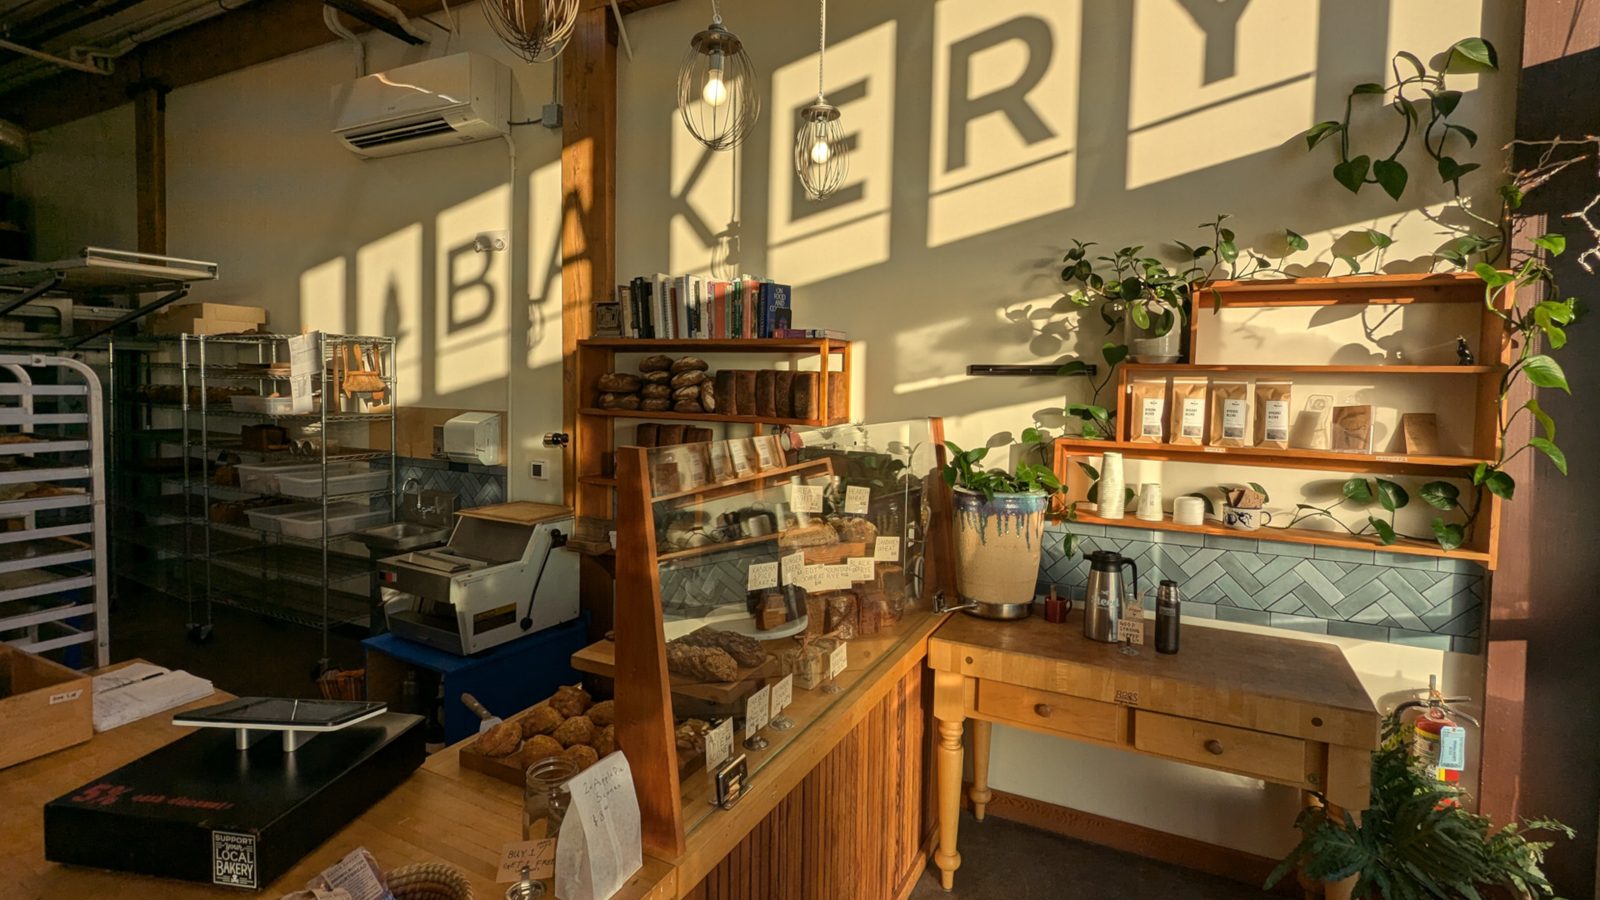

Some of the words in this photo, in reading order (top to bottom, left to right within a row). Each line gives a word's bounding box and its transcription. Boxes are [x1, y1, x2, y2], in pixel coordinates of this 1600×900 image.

[215, 833, 254, 846] SUPPORT
[215, 848, 254, 864] LOCAL
[507, 849, 528, 859] BUY
[216, 860, 254, 880] BAKERY
